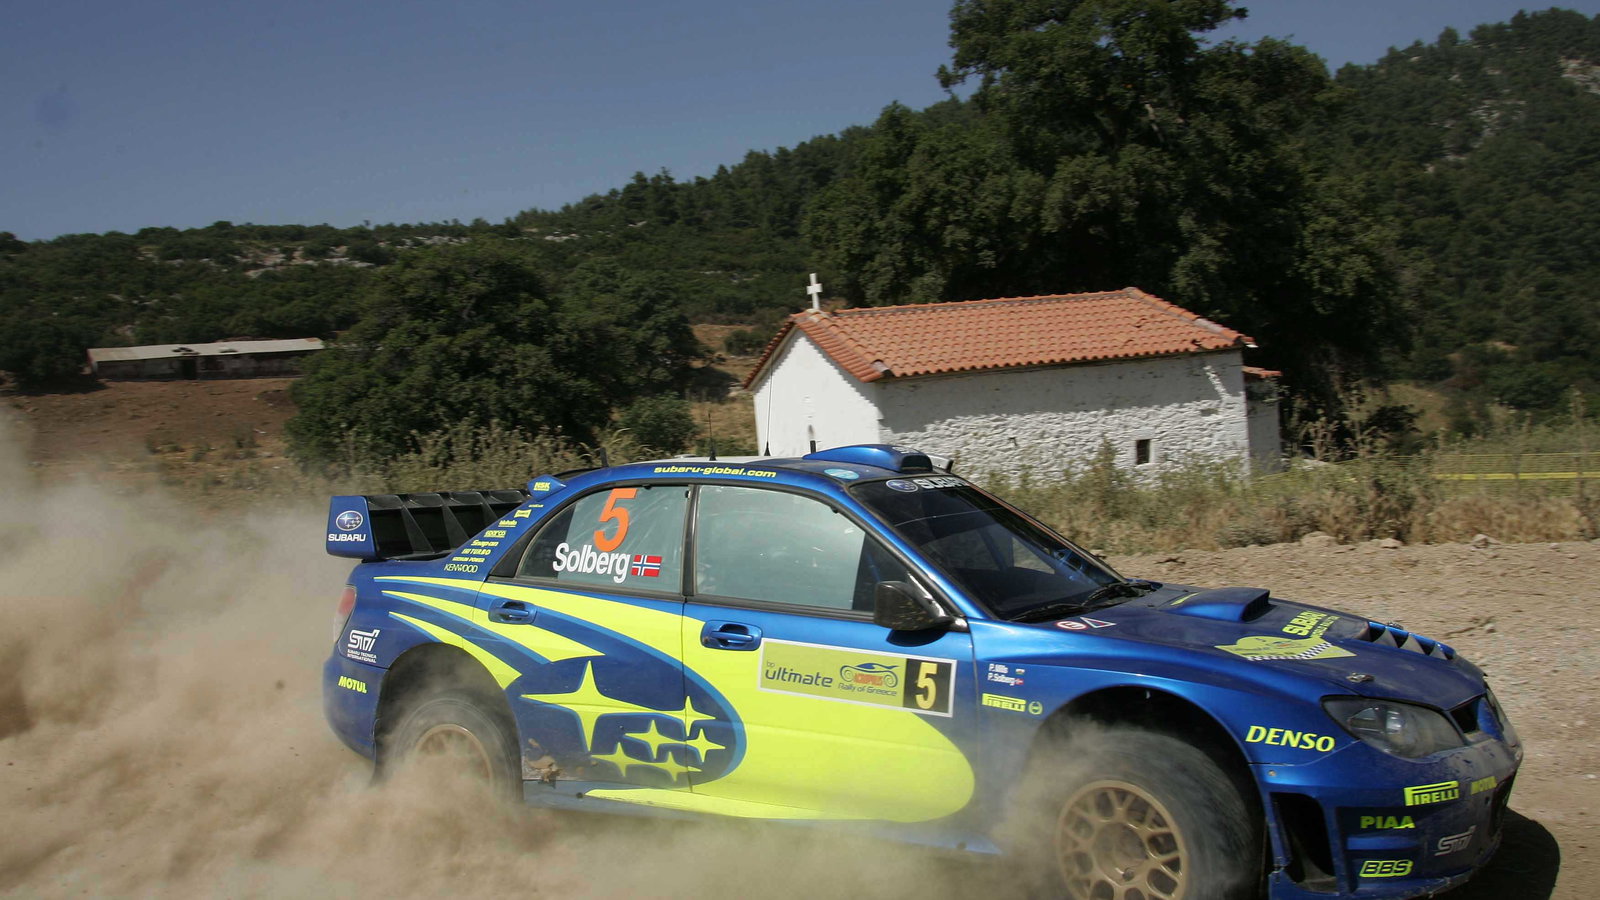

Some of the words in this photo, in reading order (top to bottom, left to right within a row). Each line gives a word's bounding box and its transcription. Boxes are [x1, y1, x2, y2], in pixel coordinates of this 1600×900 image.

[654, 466, 777, 478] subaru-global.com
[593, 487, 638, 552] 5
[328, 534, 366, 542] SUBARU
[443, 564, 478, 573] KENWOOD
[552, 542, 631, 584] Solberg
[347, 653, 377, 663] INTERNATIONAL
[338, 676, 367, 693] MOTUL
[765, 666, 833, 688] ultimate
[915, 661, 938, 710] 5
[838, 682, 856, 693] Rally
[857, 684, 868, 692] of
[868, 686, 897, 697] Greece
[982, 693, 1027, 712] PIRELLI
[1245, 725, 1336, 752] DENSO
[1404, 780, 1459, 807] PIRELLI
[1360, 815, 1416, 829] PIAA
[1359, 859, 1414, 878] BBS
